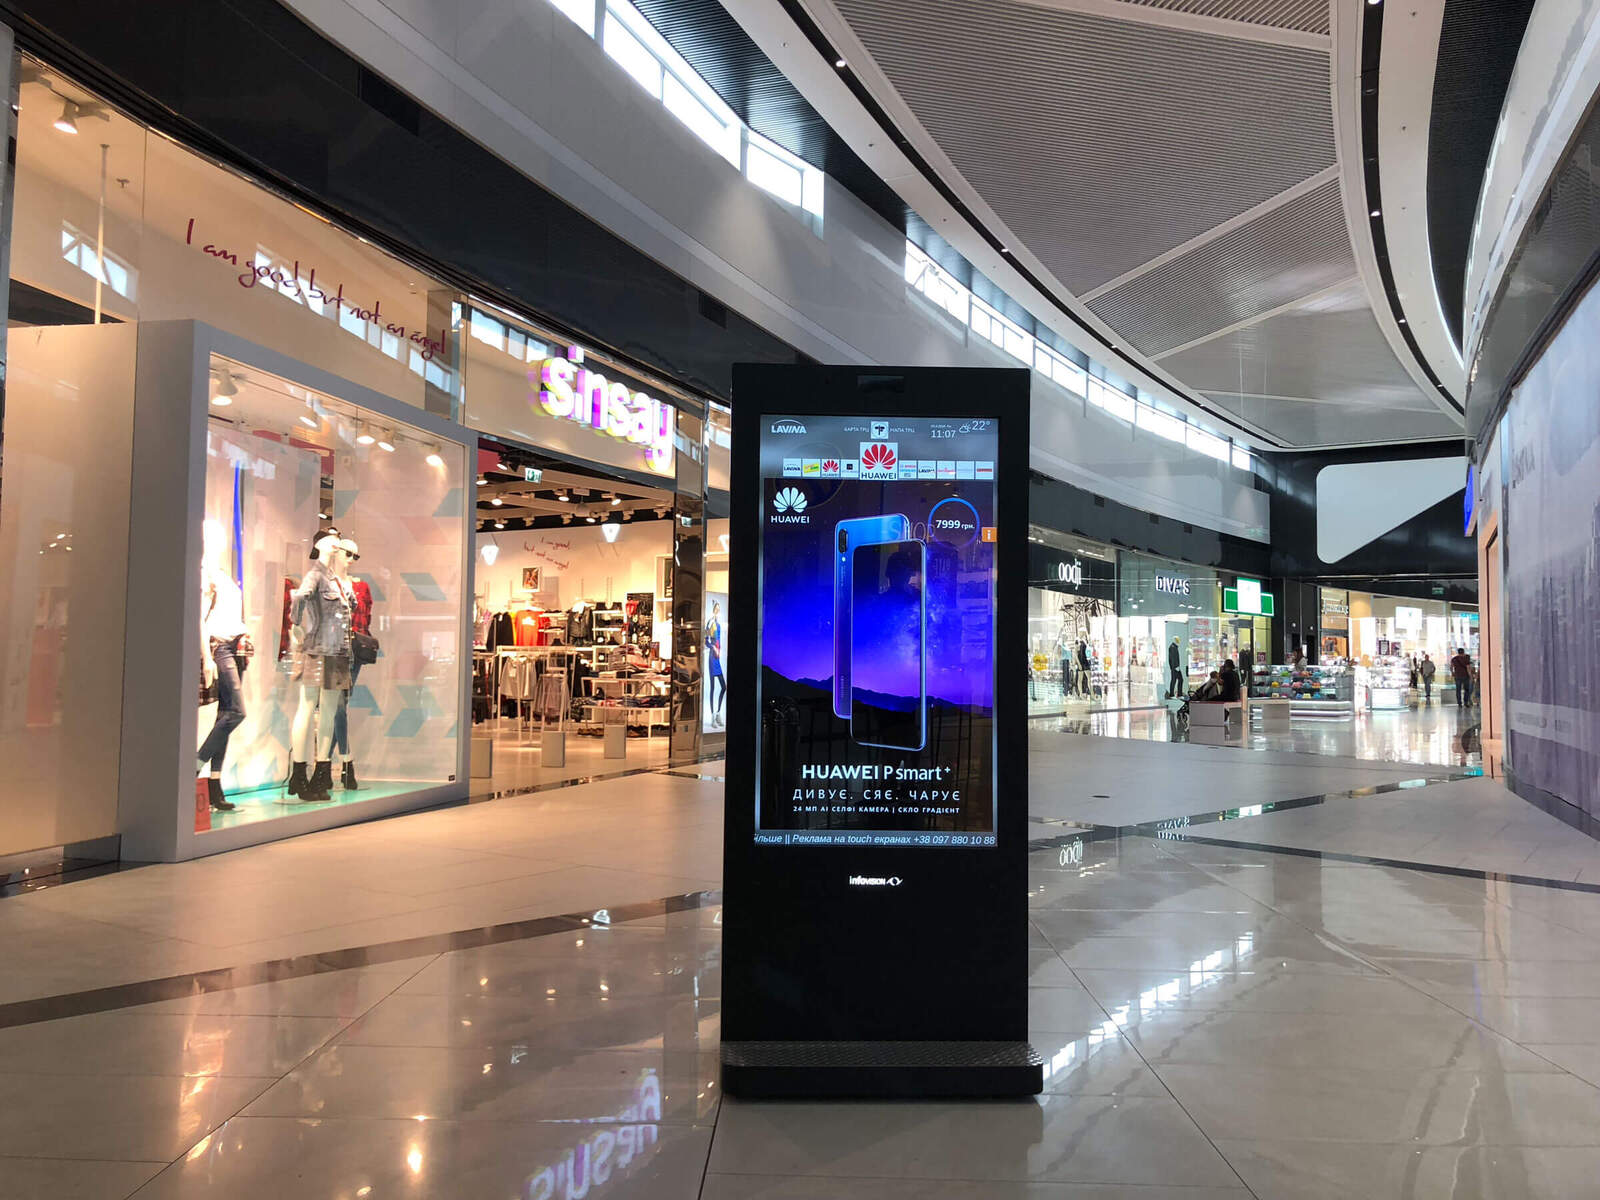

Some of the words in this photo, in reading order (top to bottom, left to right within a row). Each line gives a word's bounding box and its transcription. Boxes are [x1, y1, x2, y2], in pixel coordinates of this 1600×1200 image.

[186, 218, 194, 245] I
[203, 244, 237, 266] am
[309, 268, 345, 309] but
[349, 300, 382, 325] not
[386, 322, 405, 338] an
[410, 329, 446, 361] angel
[538, 345, 676, 473] sinsay
[771, 425, 807, 434] LAVINA
[931, 430, 957, 439] 11:07
[861, 472, 897, 480] HUAWEI
[771, 515, 810, 524] HUAWEI
[936, 520, 961, 529] 7999
[1058, 558, 1082, 591] oodji
[802, 764, 879, 780] HUAWEI
[884, 766, 893, 780] P
[792, 789, 854, 801] ДИВУЄ.
[863, 789, 899, 800] СЯЄ.
[909, 790, 961, 801] ЧАРУЄ
[792, 834, 832, 844] Реклама
[834, 836, 846, 844] на
[848, 834, 872, 844] touch
[874, 836, 911, 846] екранах
[914, 835, 931, 844] +38
[933, 835, 950, 844] 097
[951, 836, 969, 845] 880
[971, 836, 982, 845] 10
[984, 836, 996, 845] 88
